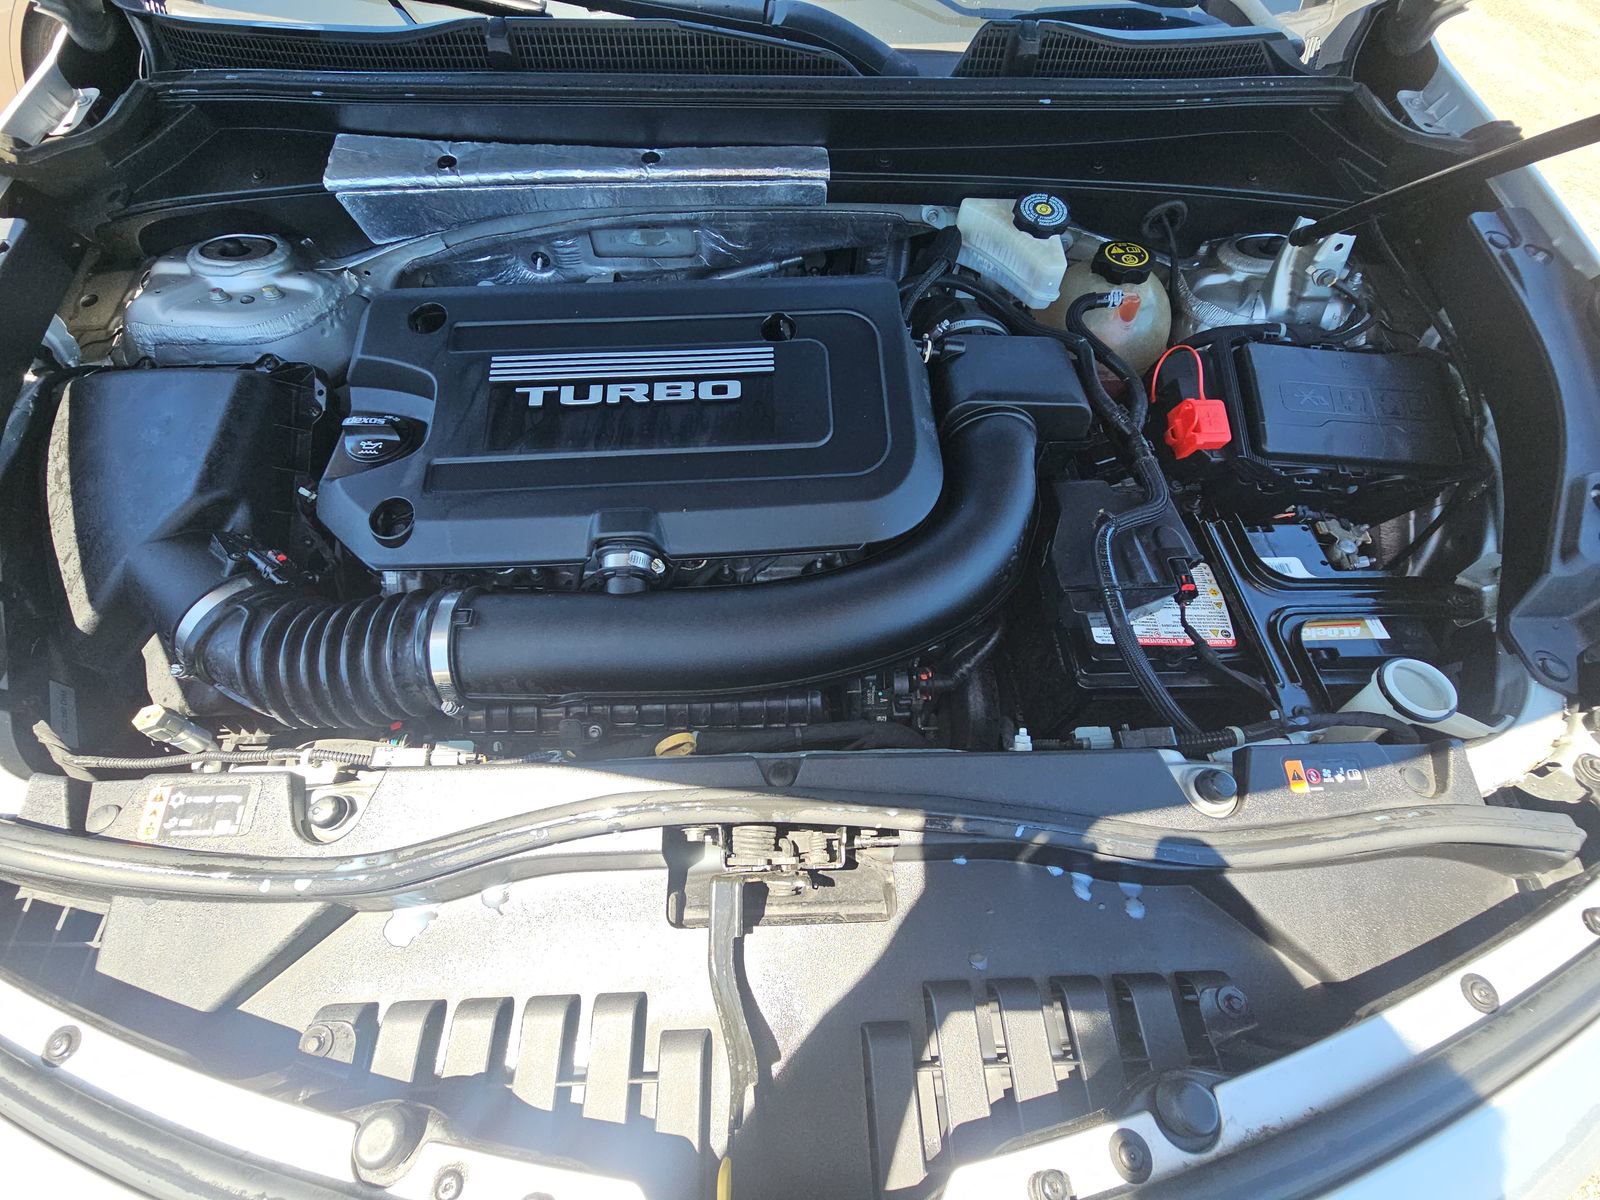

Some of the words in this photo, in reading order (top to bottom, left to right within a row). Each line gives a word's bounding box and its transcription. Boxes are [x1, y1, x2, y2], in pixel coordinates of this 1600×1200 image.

[515, 380, 741, 406] TURBO
[346, 416, 386, 425] dexos
[1301, 627, 1361, 638] ACDelc
